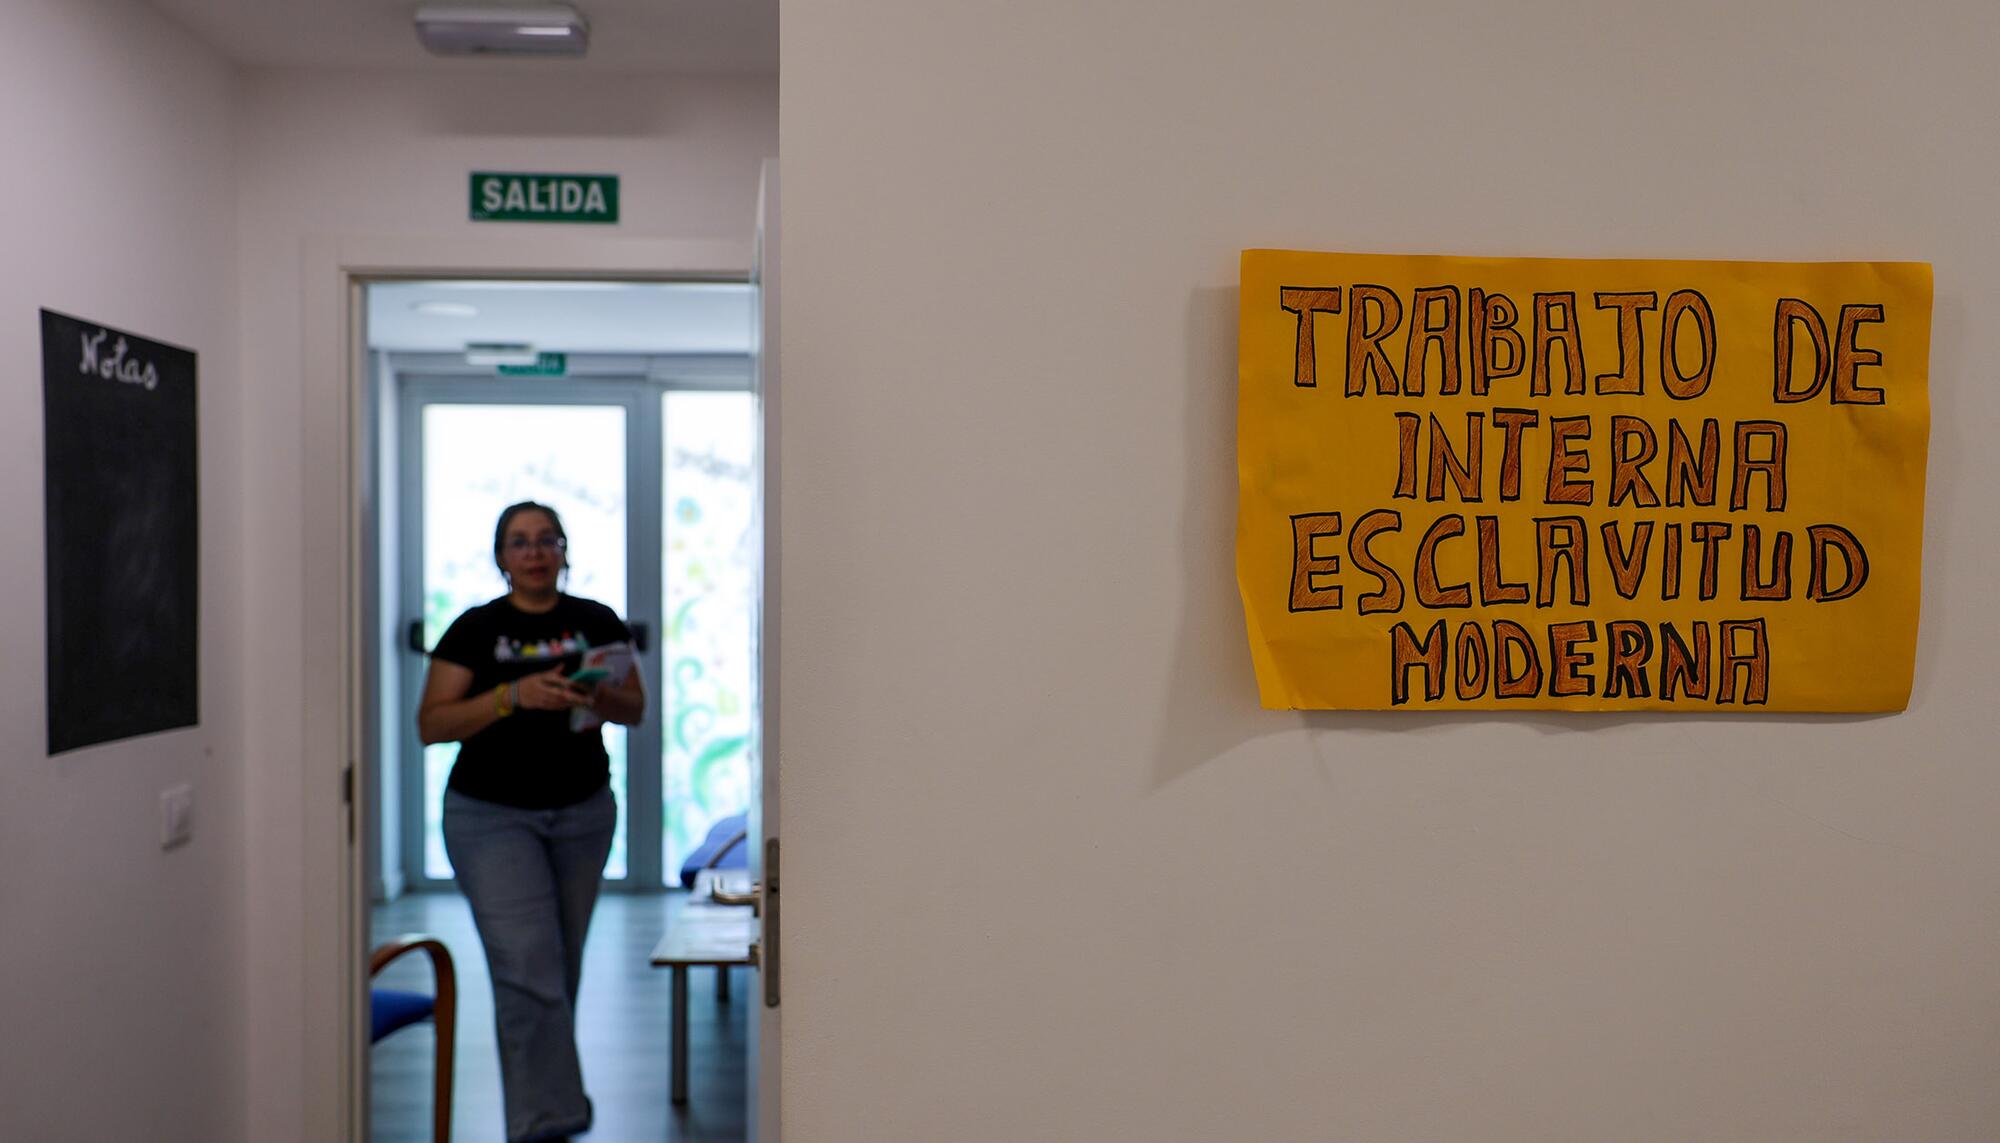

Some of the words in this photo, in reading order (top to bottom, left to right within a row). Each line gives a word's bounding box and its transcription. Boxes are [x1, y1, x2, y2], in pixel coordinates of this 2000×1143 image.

[481, 178, 606, 213] SALIDA
[80, 329, 159, 391] Notas
[1280, 284, 1717, 400] TRABAJO
[1774, 297, 1886, 405] DE
[1392, 408, 1788, 512] INTERNA
[1288, 509, 1870, 616] ESCLAVITUD
[1388, 617, 1769, 706] MODERNA
